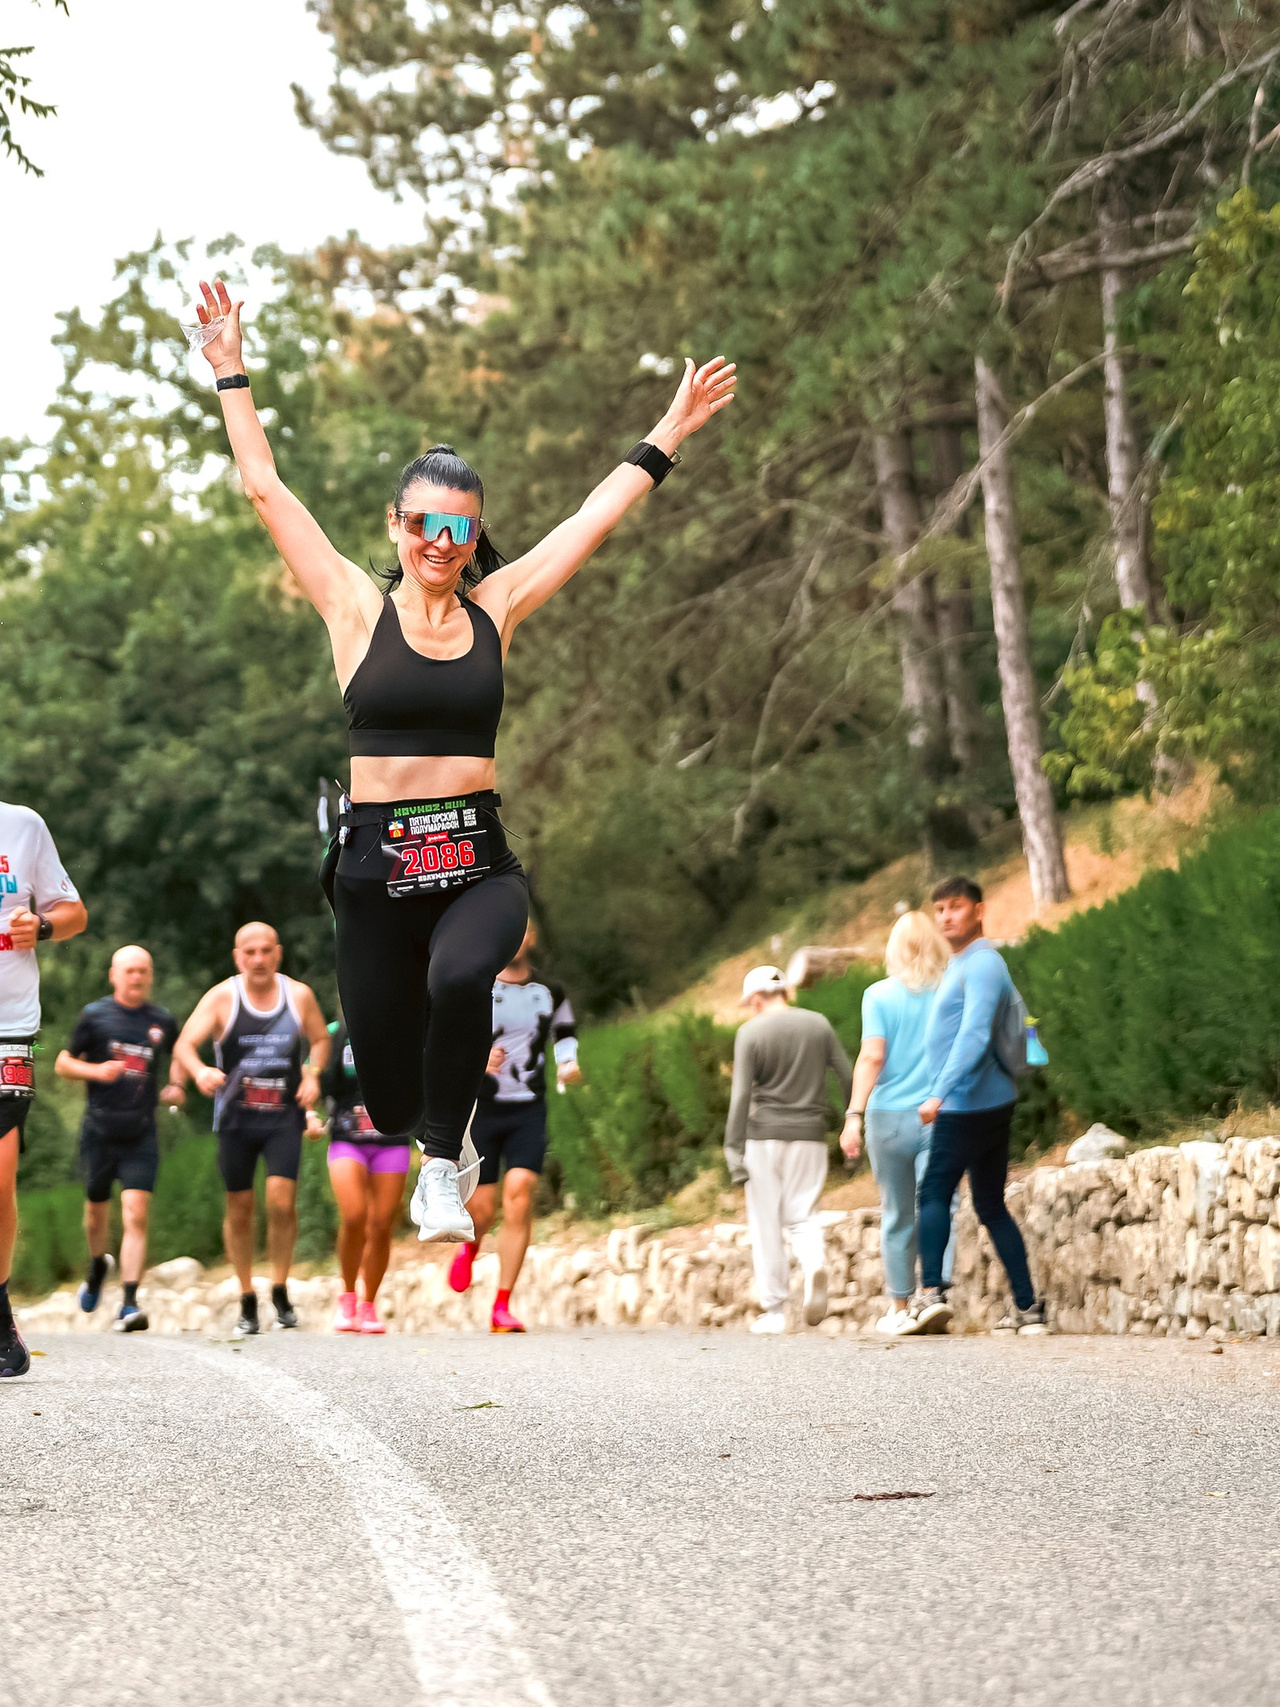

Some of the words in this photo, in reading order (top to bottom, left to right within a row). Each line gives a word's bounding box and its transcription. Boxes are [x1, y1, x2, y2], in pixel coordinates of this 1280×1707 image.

[409, 809, 459, 827] ПЯТИГОРСКИЙ
[410, 819, 460, 835] ПОЛУМАРАФОН
[401, 840, 476, 876] 2086
[418, 869, 466, 882] ПОЛУМАРАФОН
